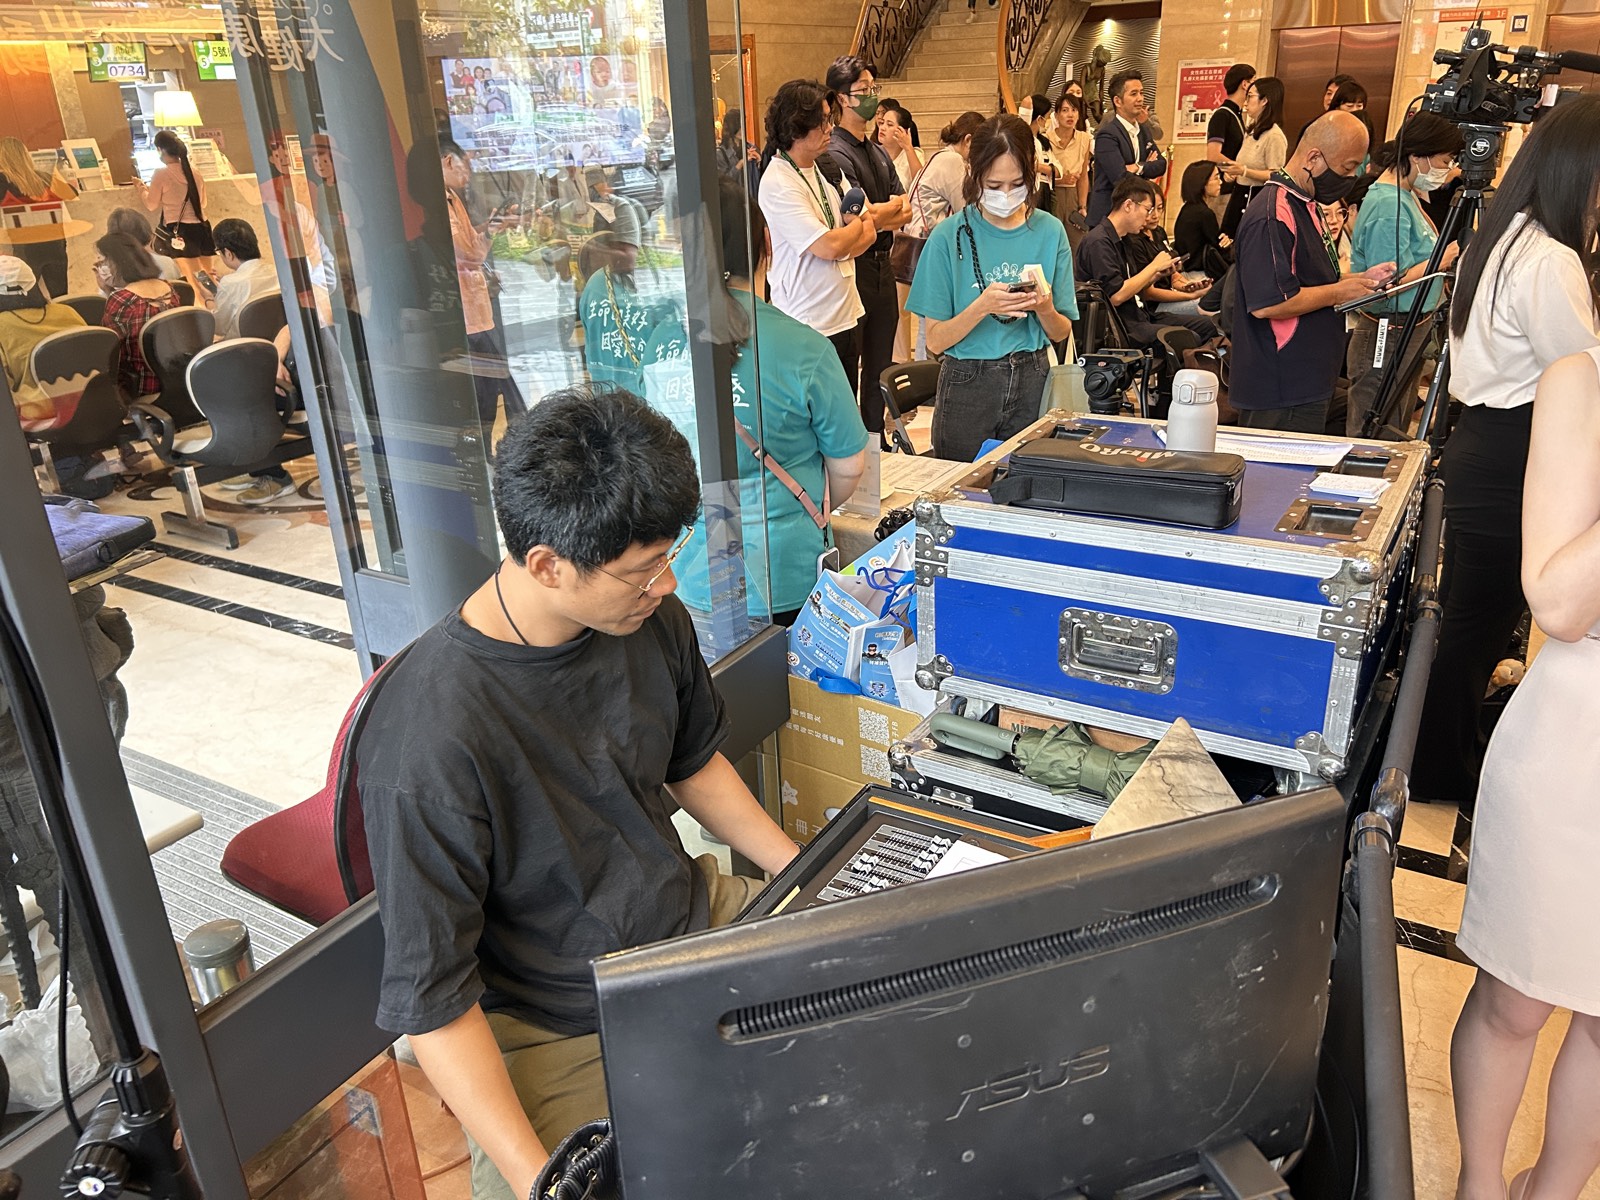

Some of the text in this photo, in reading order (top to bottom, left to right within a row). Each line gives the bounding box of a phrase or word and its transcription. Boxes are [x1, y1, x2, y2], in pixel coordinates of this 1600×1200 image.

[1497, 10, 1507, 18] 1F
[109, 65, 144, 76] 0734
[944, 1044, 1111, 1122] ASUS
